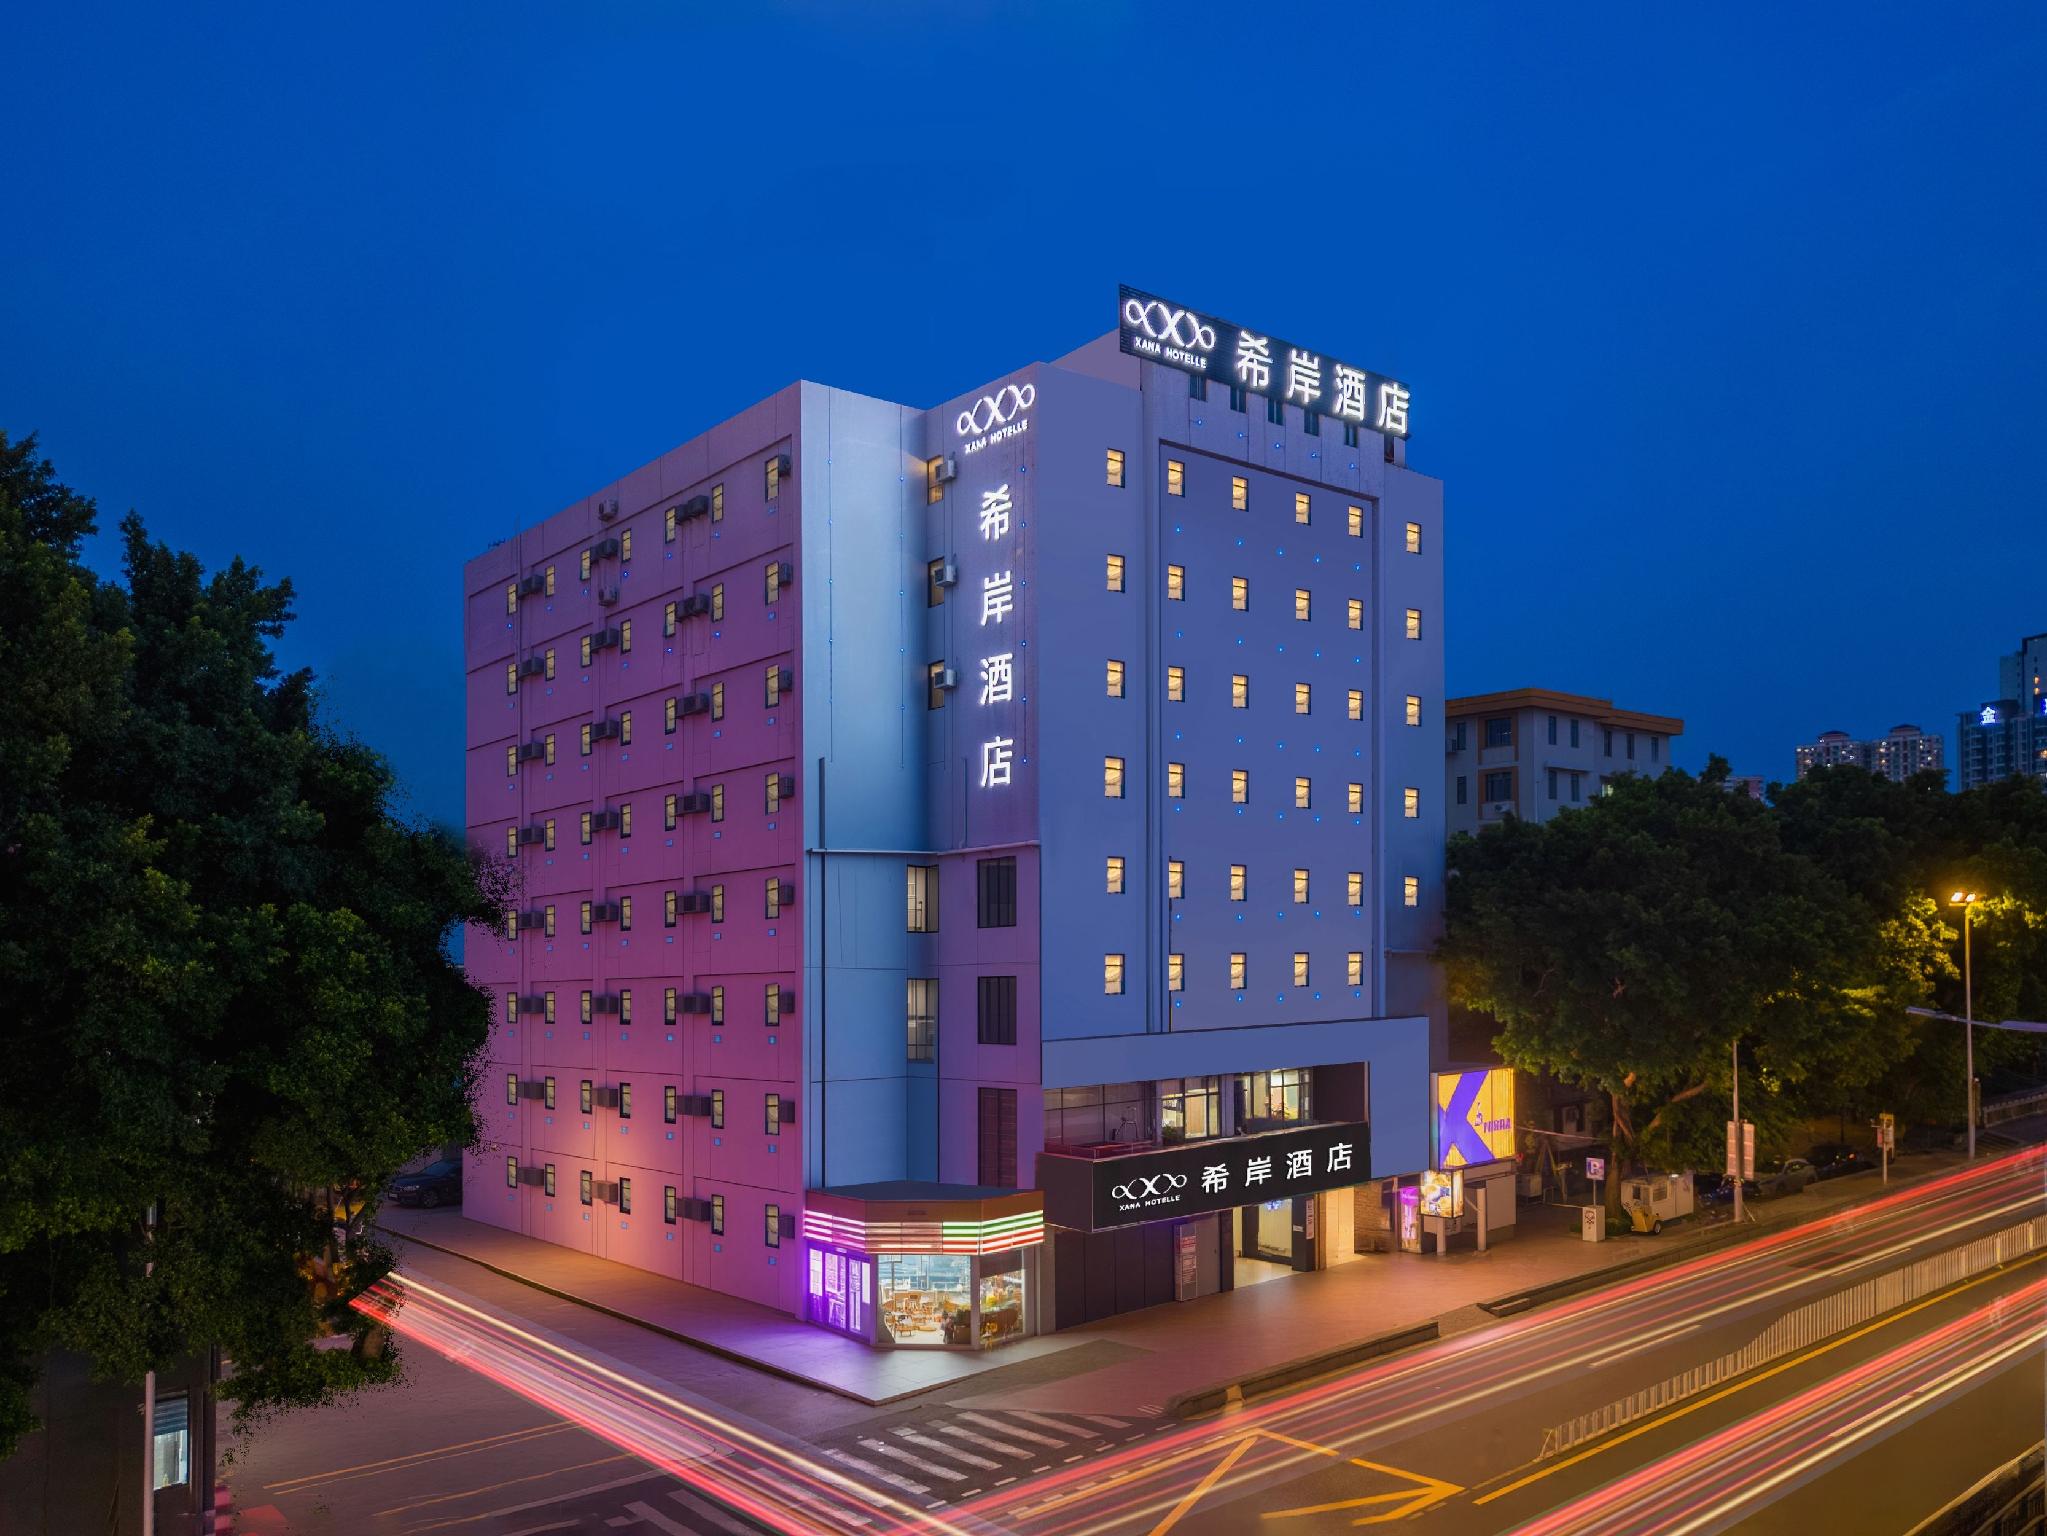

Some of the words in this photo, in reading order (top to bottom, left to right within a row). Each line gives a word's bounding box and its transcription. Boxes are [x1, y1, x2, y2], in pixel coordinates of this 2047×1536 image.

[1135, 336, 1161, 353] XANA
[1165, 347, 1207, 369] HOTELLE
[1237, 330, 1410, 434] 希岸酒店
[964, 436, 987, 454] XANA
[990, 418, 1028, 444] HOTELLE
[979, 483, 1014, 788] 希岸酒店
[1200, 1142, 1353, 1194] 希岸酒店
[1119, 1202, 1141, 1212] XANA
[1144, 1194, 1181, 1207] HOTELLE
